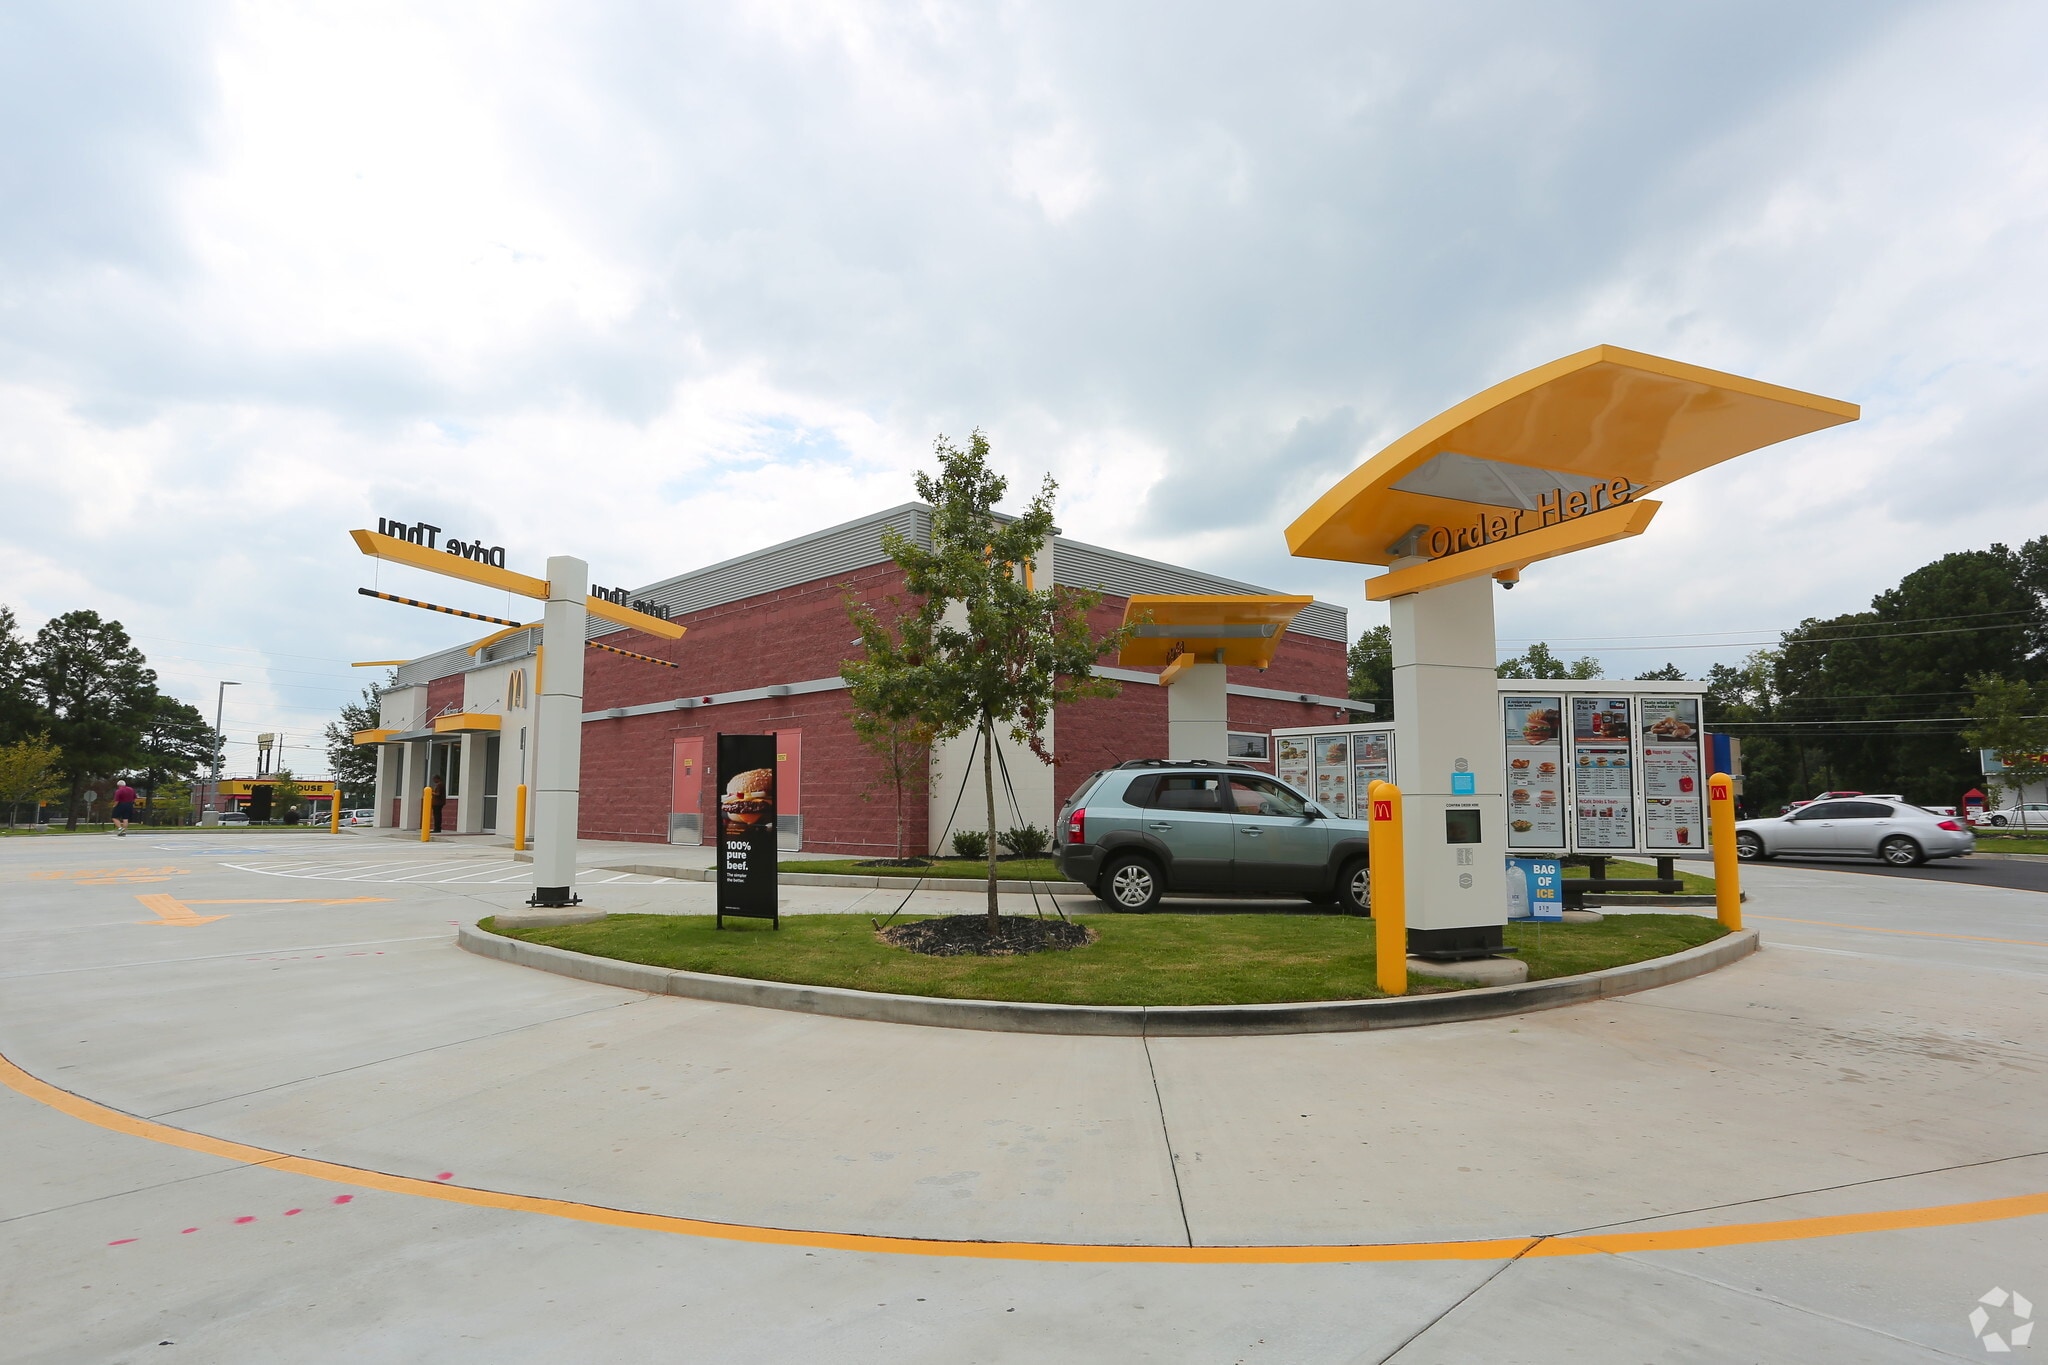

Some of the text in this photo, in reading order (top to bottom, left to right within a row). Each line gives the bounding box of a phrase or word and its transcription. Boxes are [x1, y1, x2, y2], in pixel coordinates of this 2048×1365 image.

[1428, 476, 1633, 559] Order Here
[726, 840, 752, 851] 100%
[726, 851, 747, 860] pure
[726, 860, 749, 871] beef.
[1533, 864, 1556, 874] BAG
[1537, 876, 1552, 887] OF
[1536, 888, 1555, 899] ICE
